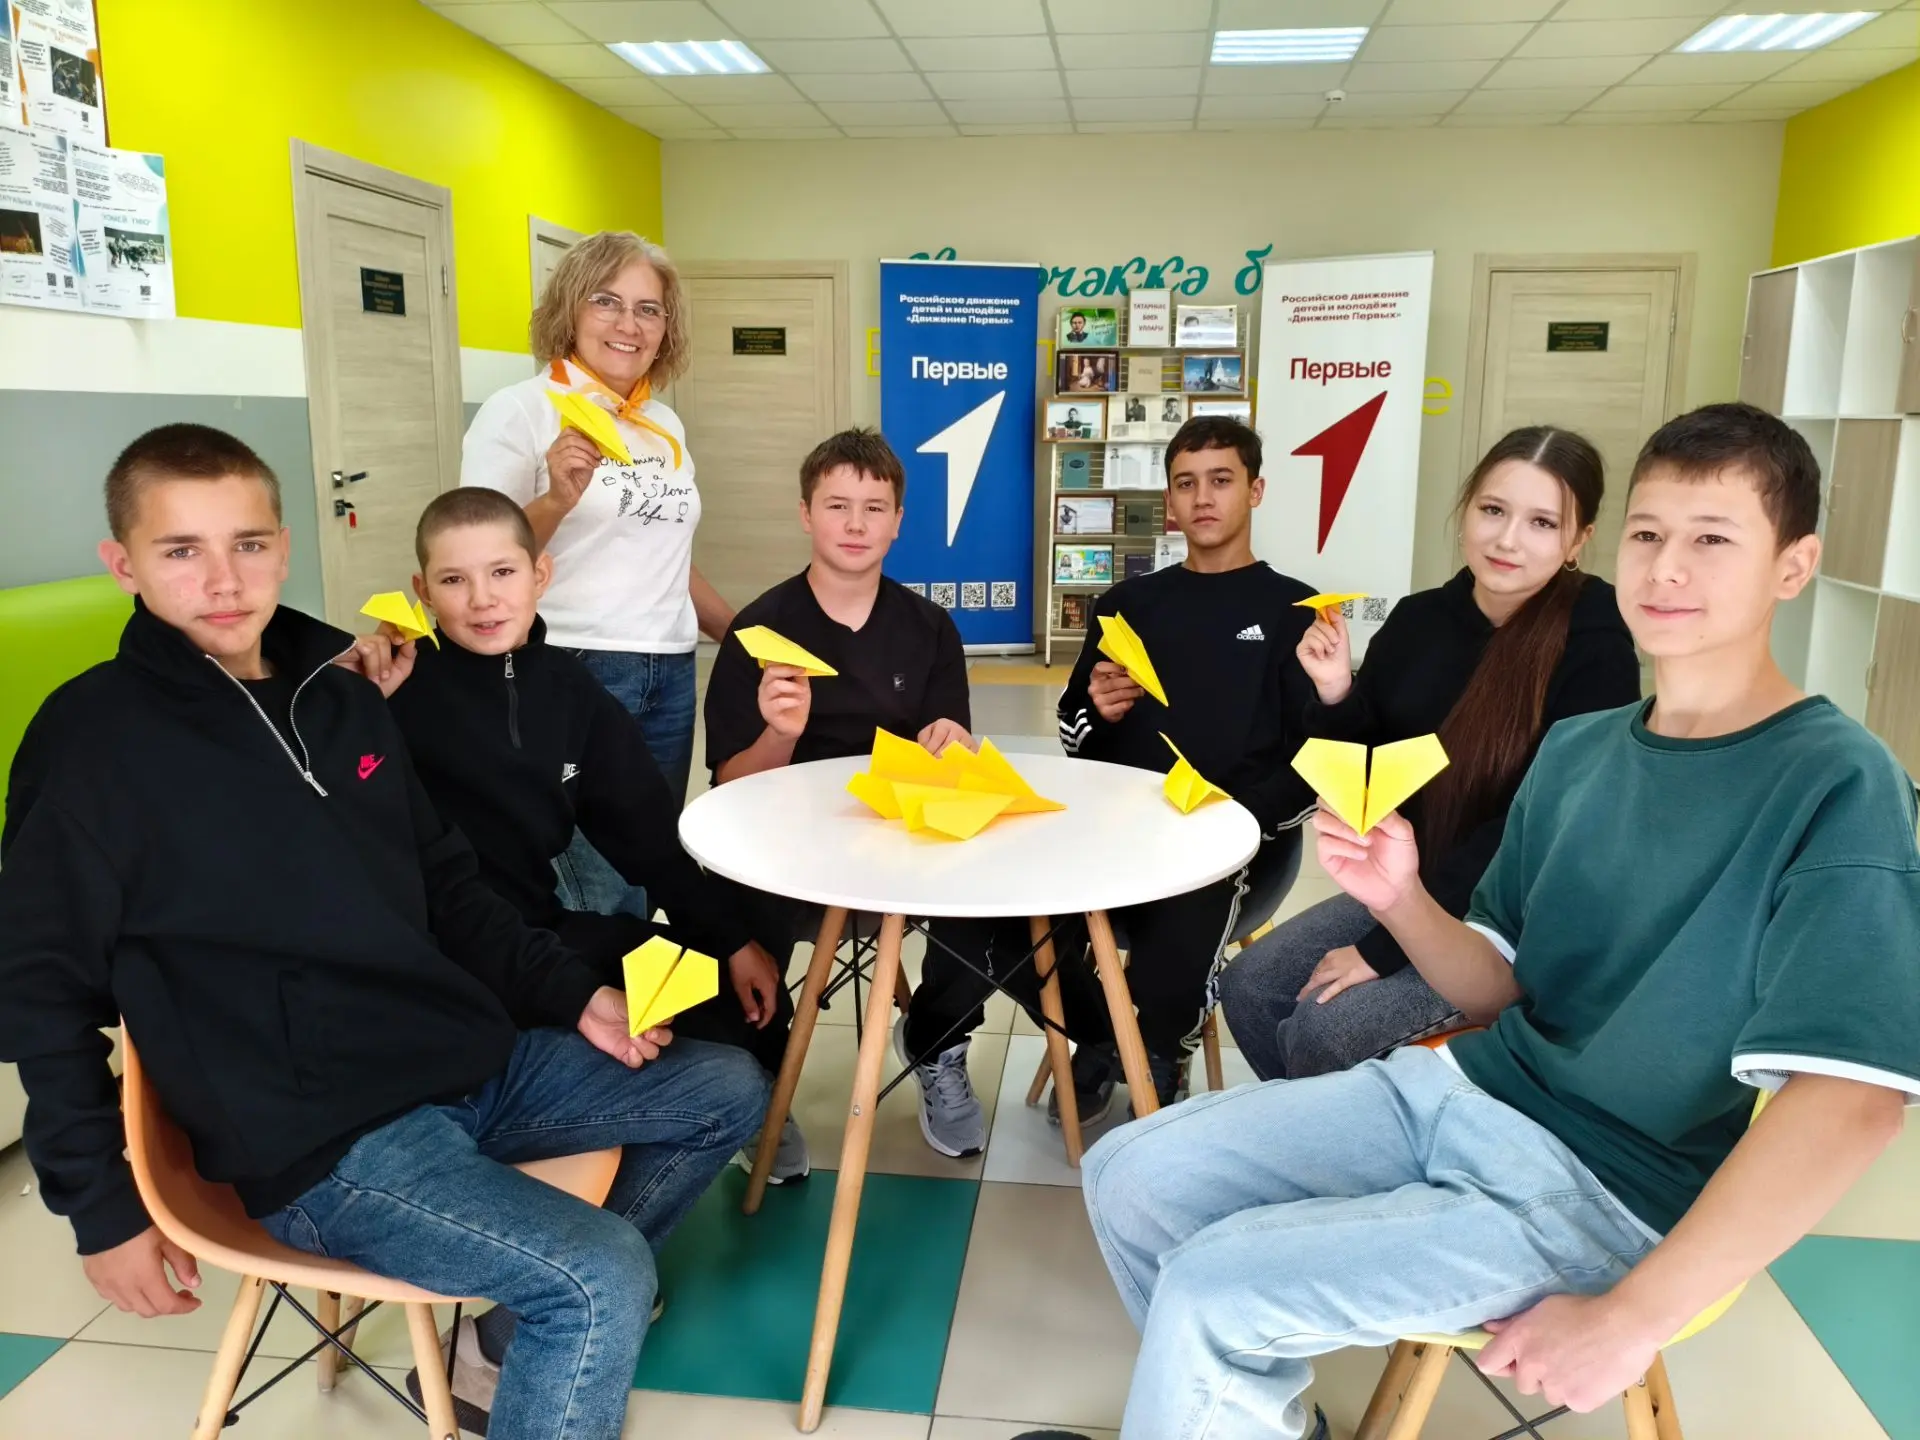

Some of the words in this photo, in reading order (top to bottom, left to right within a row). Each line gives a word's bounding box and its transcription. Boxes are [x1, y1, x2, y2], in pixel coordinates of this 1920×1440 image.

[900, 294, 965, 305] Российское
[966, 296, 1020, 306] движение
[1281, 293, 1349, 304] Российское
[1350, 290, 1410, 301] движение
[911, 305, 944, 314] детей
[954, 305, 1009, 315] молодёжи
[1293, 303, 1326, 313] детей
[1336, 301, 1397, 311] молодёжи
[906, 314, 967, 324] «Движение
[968, 315, 1014, 326] Первых»
[911, 356, 1009, 386] Первые
[1290, 357, 1392, 386] Первые
[628, 499, 669, 526] life
